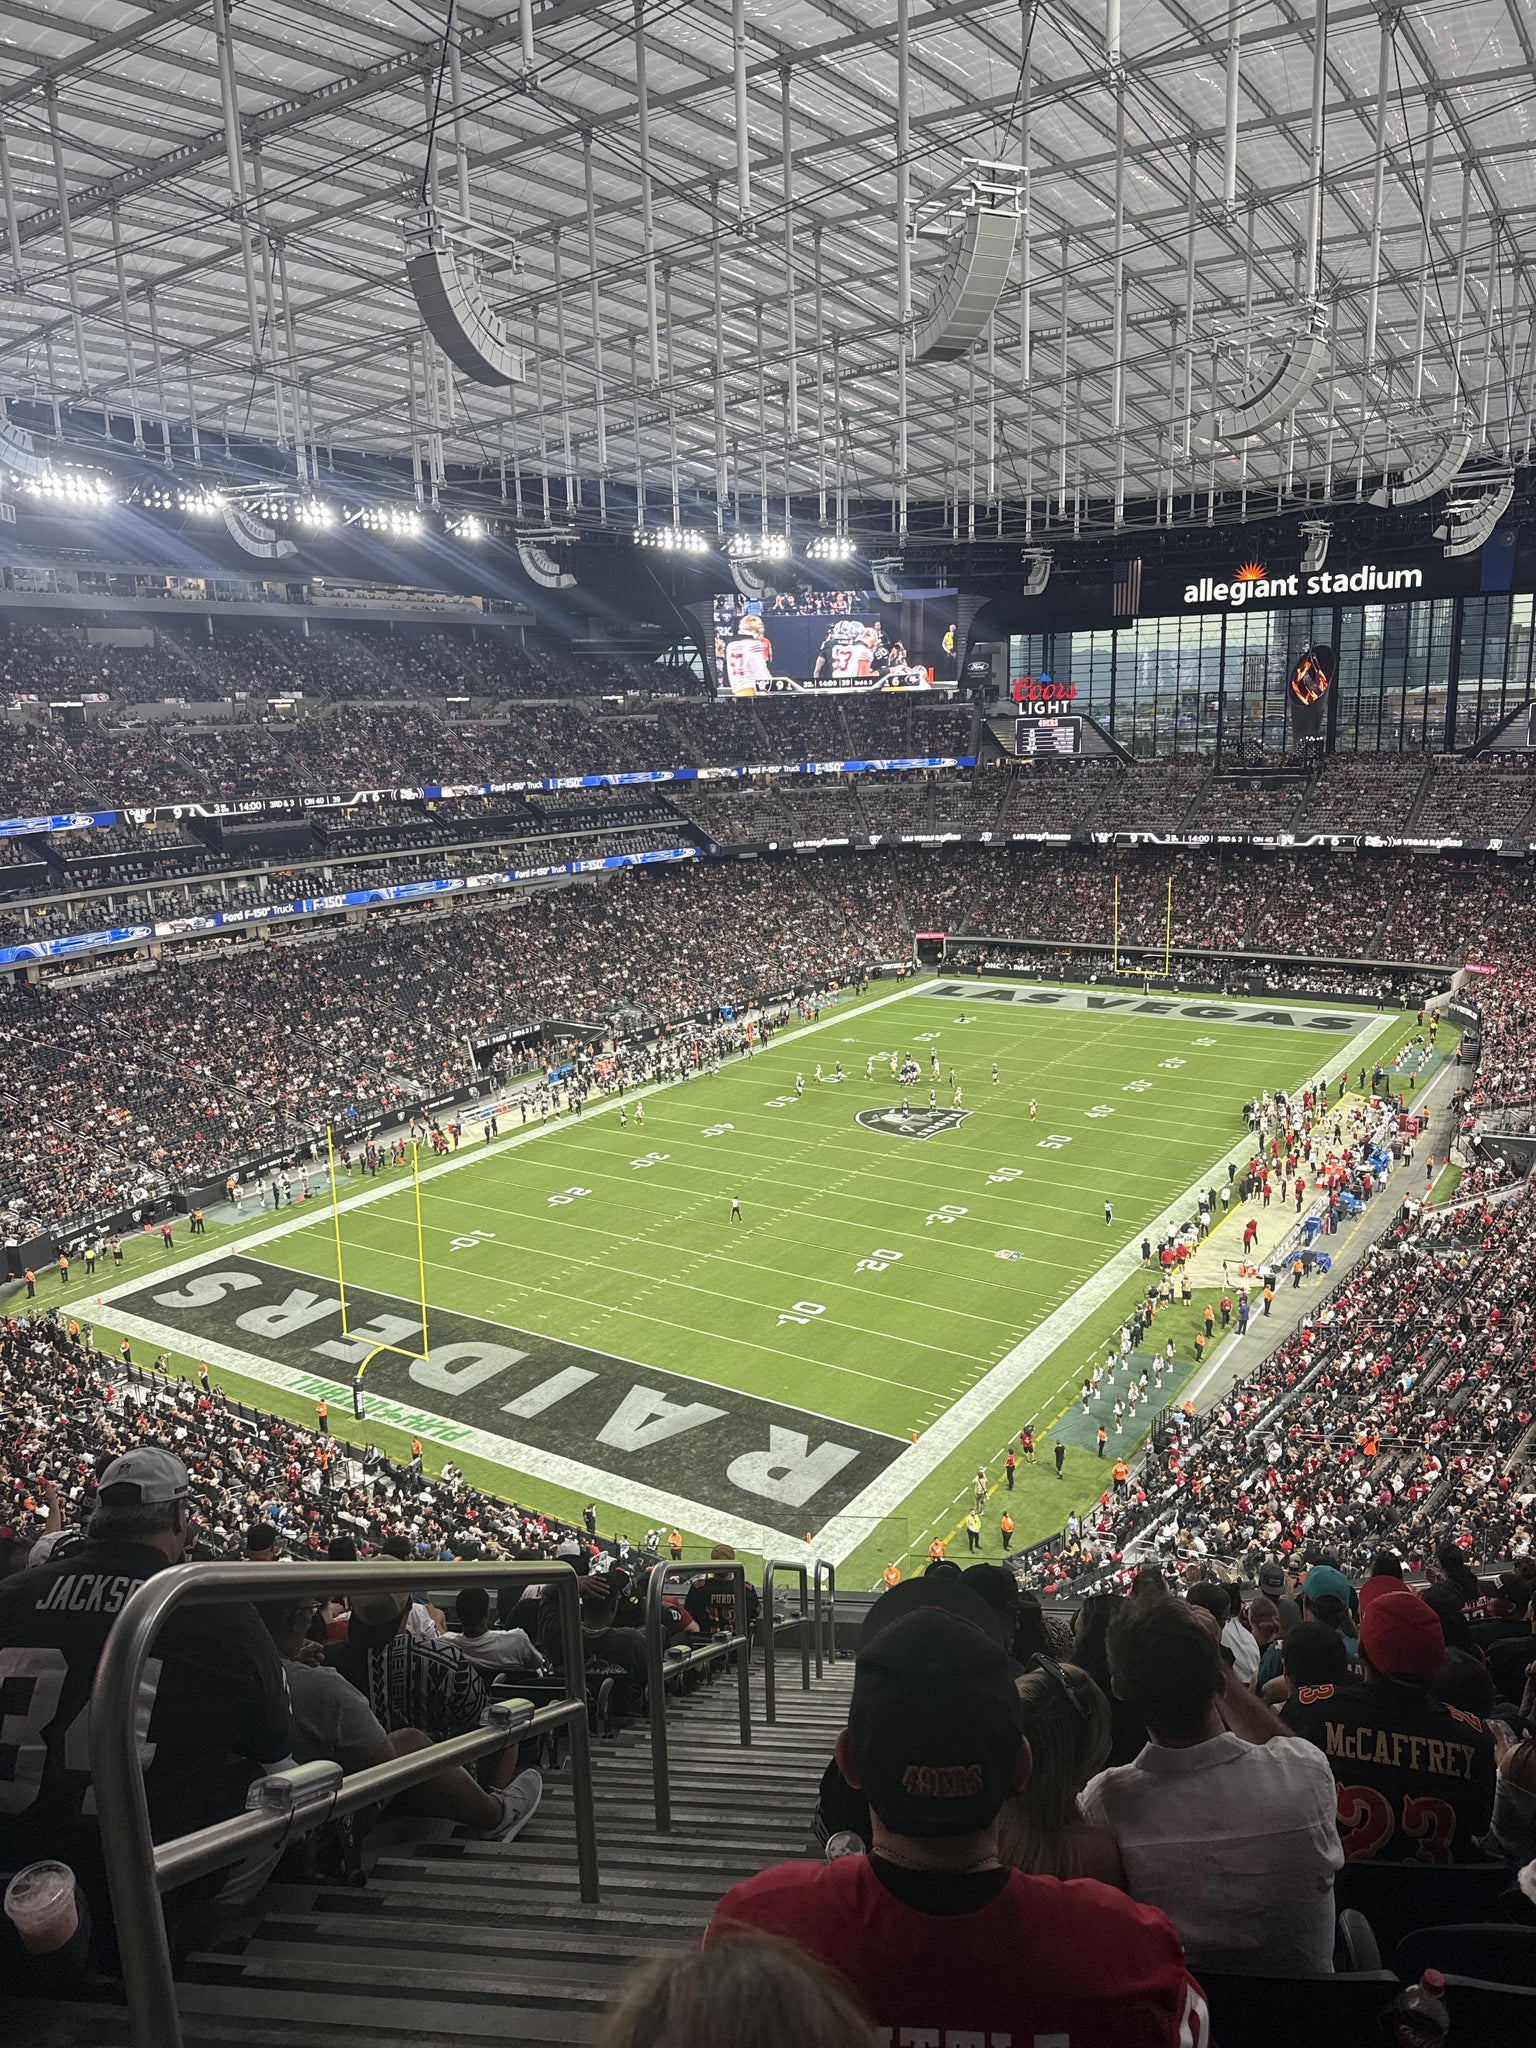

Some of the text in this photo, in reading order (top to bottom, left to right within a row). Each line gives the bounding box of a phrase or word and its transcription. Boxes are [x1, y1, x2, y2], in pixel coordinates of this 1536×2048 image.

[1184, 566, 1422, 606] allegiant stadium
[776, 680, 784, 690] 9
[891, 677, 899, 686] 6
[1012, 677, 1078, 701] Coors
[1019, 701, 1070, 715] LIGHT
[491, 784, 506, 792] Ford
[527, 781, 543, 789] Truck
[372, 793, 380, 802] 6
[173, 807, 182, 819] 9
[239, 801, 261, 811] 14:00
[1130, 835, 1137, 843] 9
[1188, 835, 1210, 843] 14:00
[1331, 838, 1339, 846] 6
[1403, 838, 1429, 846] VEGAS
[1429, 837, 1463, 848] RAIDERS
[515, 870, 530, 879] Ford
[550, 865, 567, 874] Truck
[222, 912, 243, 924] Ford
[272, 904, 295, 915] Truck
[932, 985, 1066, 1004] LAS
[1086, 997, 1358, 1031] VEGAS
[1157, 1058, 1187, 1070] 20
[1122, 1080, 1153, 1093] 30
[763, 1095, 799, 1108] 50
[1084, 1105, 1116, 1118] 40
[700, 1122, 735, 1136] 40
[1036, 1134, 1072, 1149] 50
[629, 1152, 671, 1168] 30
[987, 1167, 1024, 1182] 40
[547, 1187, 592, 1204] 20
[925, 1204, 969, 1224] 30
[450, 1229, 496, 1248] 10
[856, 1248, 904, 1272] 20
[778, 1301, 827, 1325] 10
[152, 1271, 861, 1508] RAIDERS
[402, 1413, 473, 1442] PLAY
[1324, 1721, 1475, 1780] McCAFFREY
